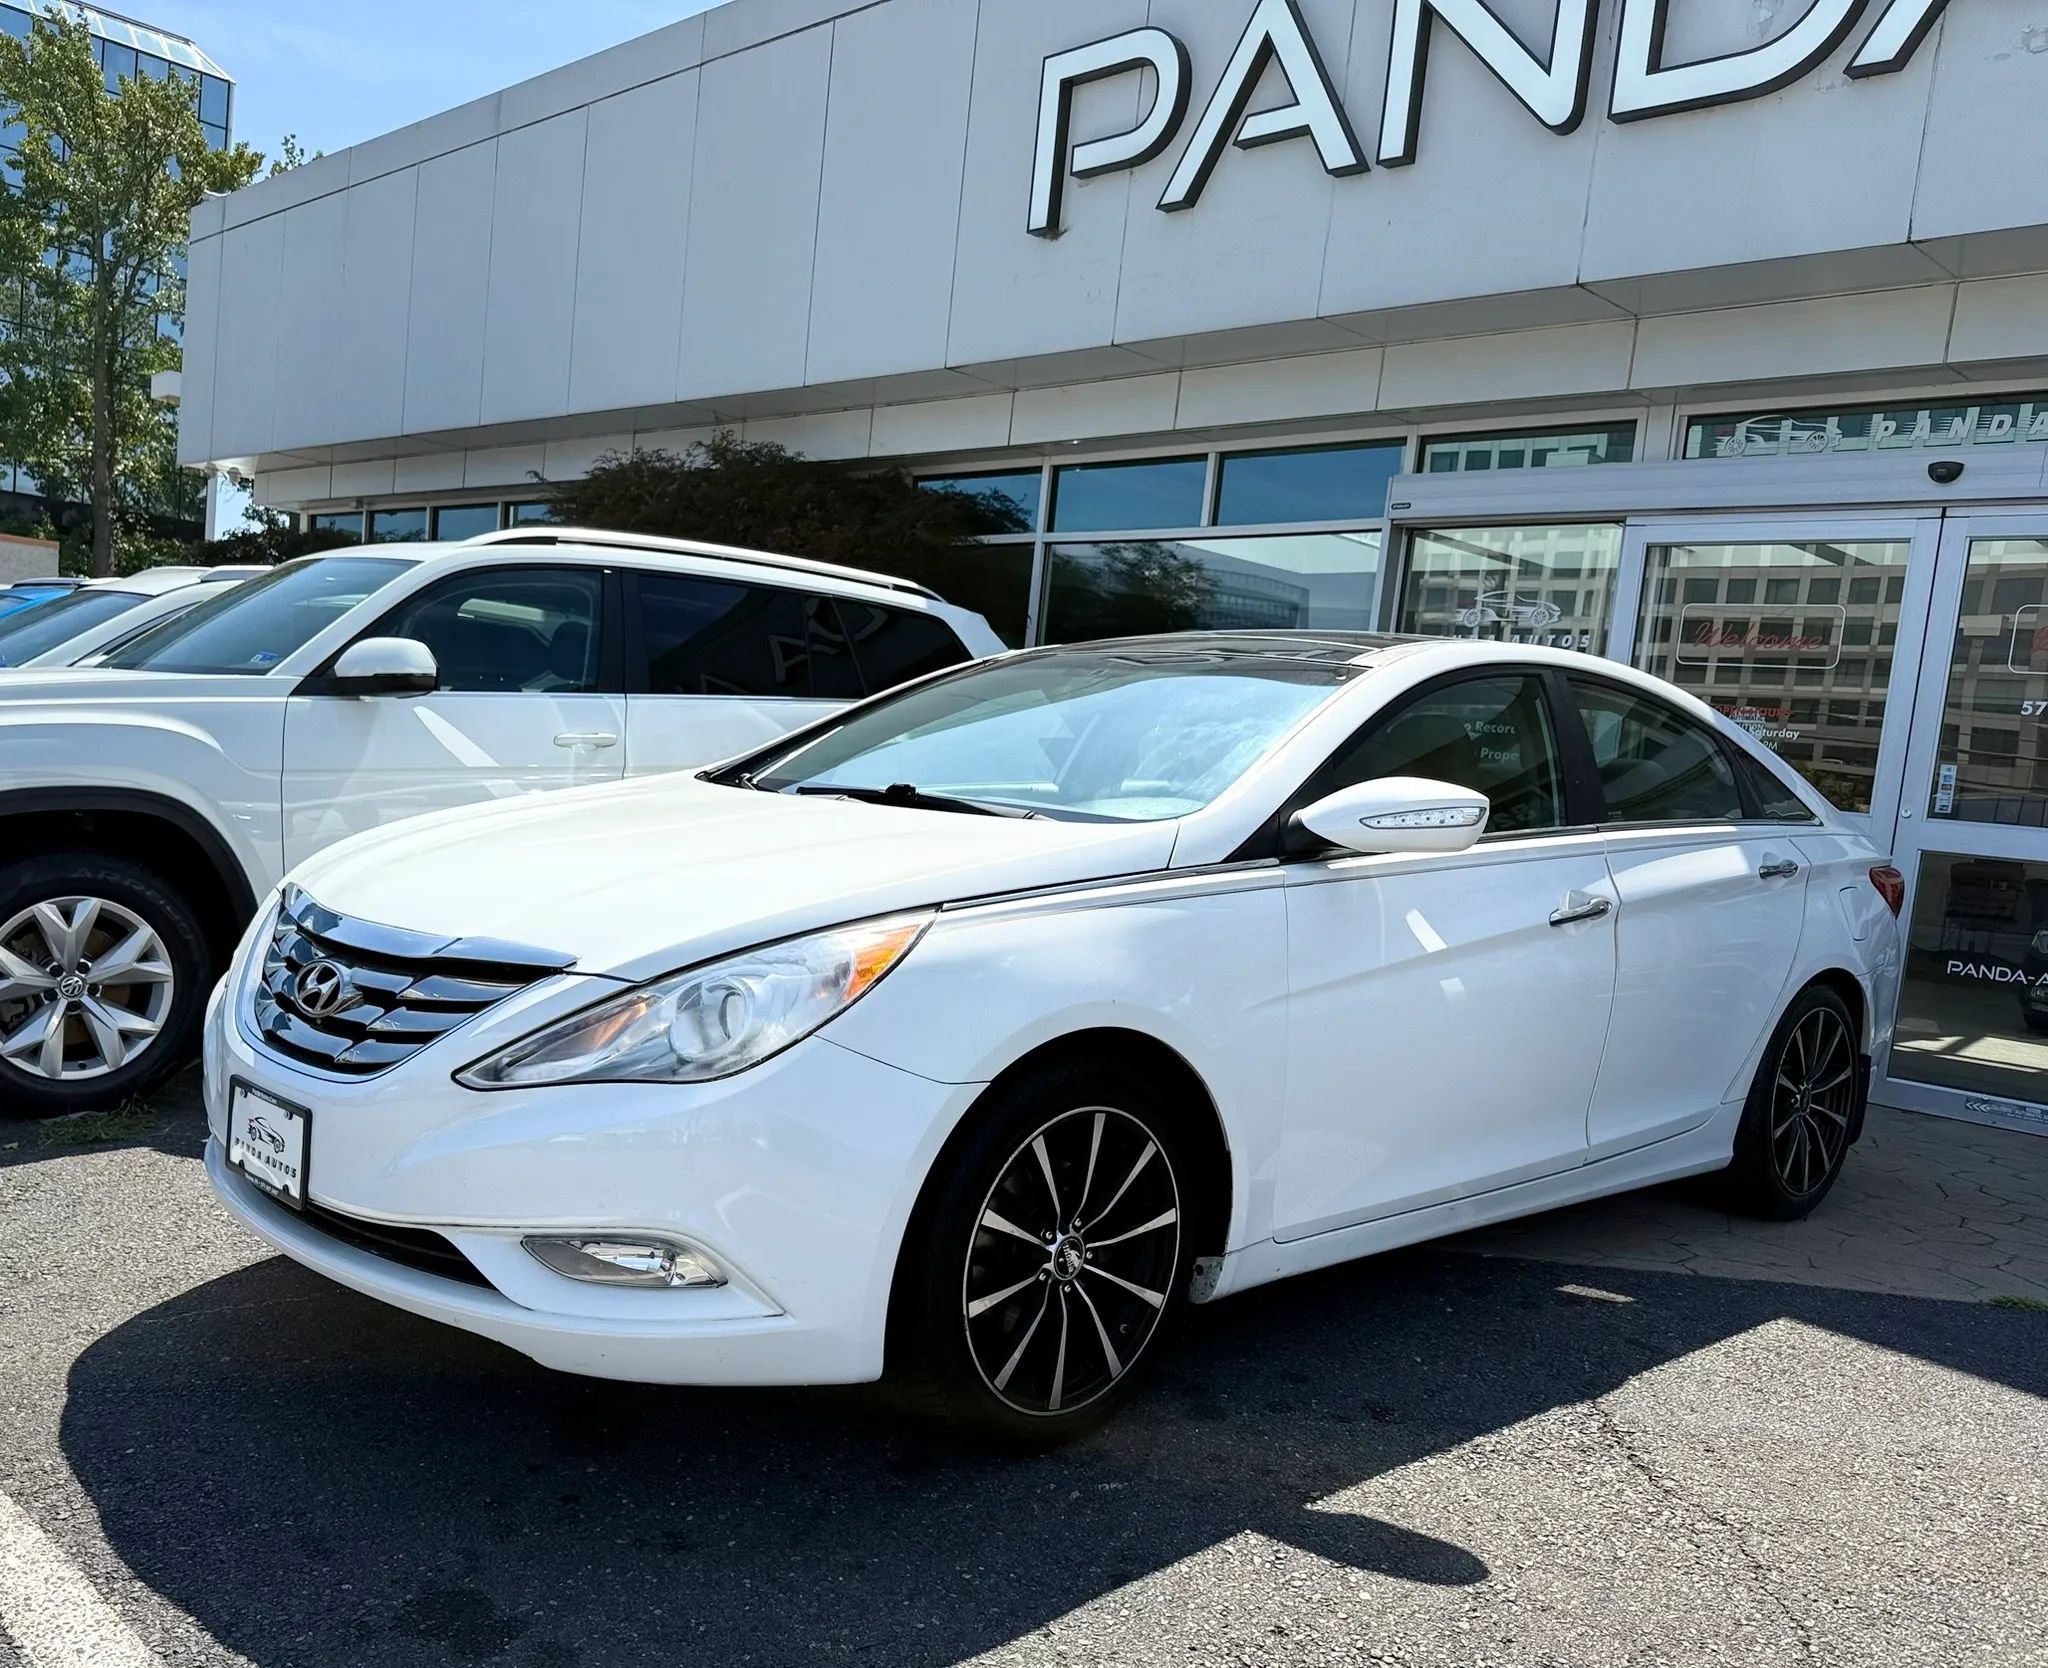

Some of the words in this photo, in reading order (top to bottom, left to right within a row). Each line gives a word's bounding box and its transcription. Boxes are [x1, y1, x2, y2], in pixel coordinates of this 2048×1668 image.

[1027, 0, 1950, 238] PAND
[1871, 411, 2048, 442] PANDA
[1694, 622, 1823, 649] Welcome
[2020, 700, 2048, 715] 57
[1748, 728, 1800, 741] Saturday
[1946, 960, 2048, 986] PANDA-A
[234, 1136, 262, 1161] PANDA
[264, 1155, 297, 1178] AUTOS
